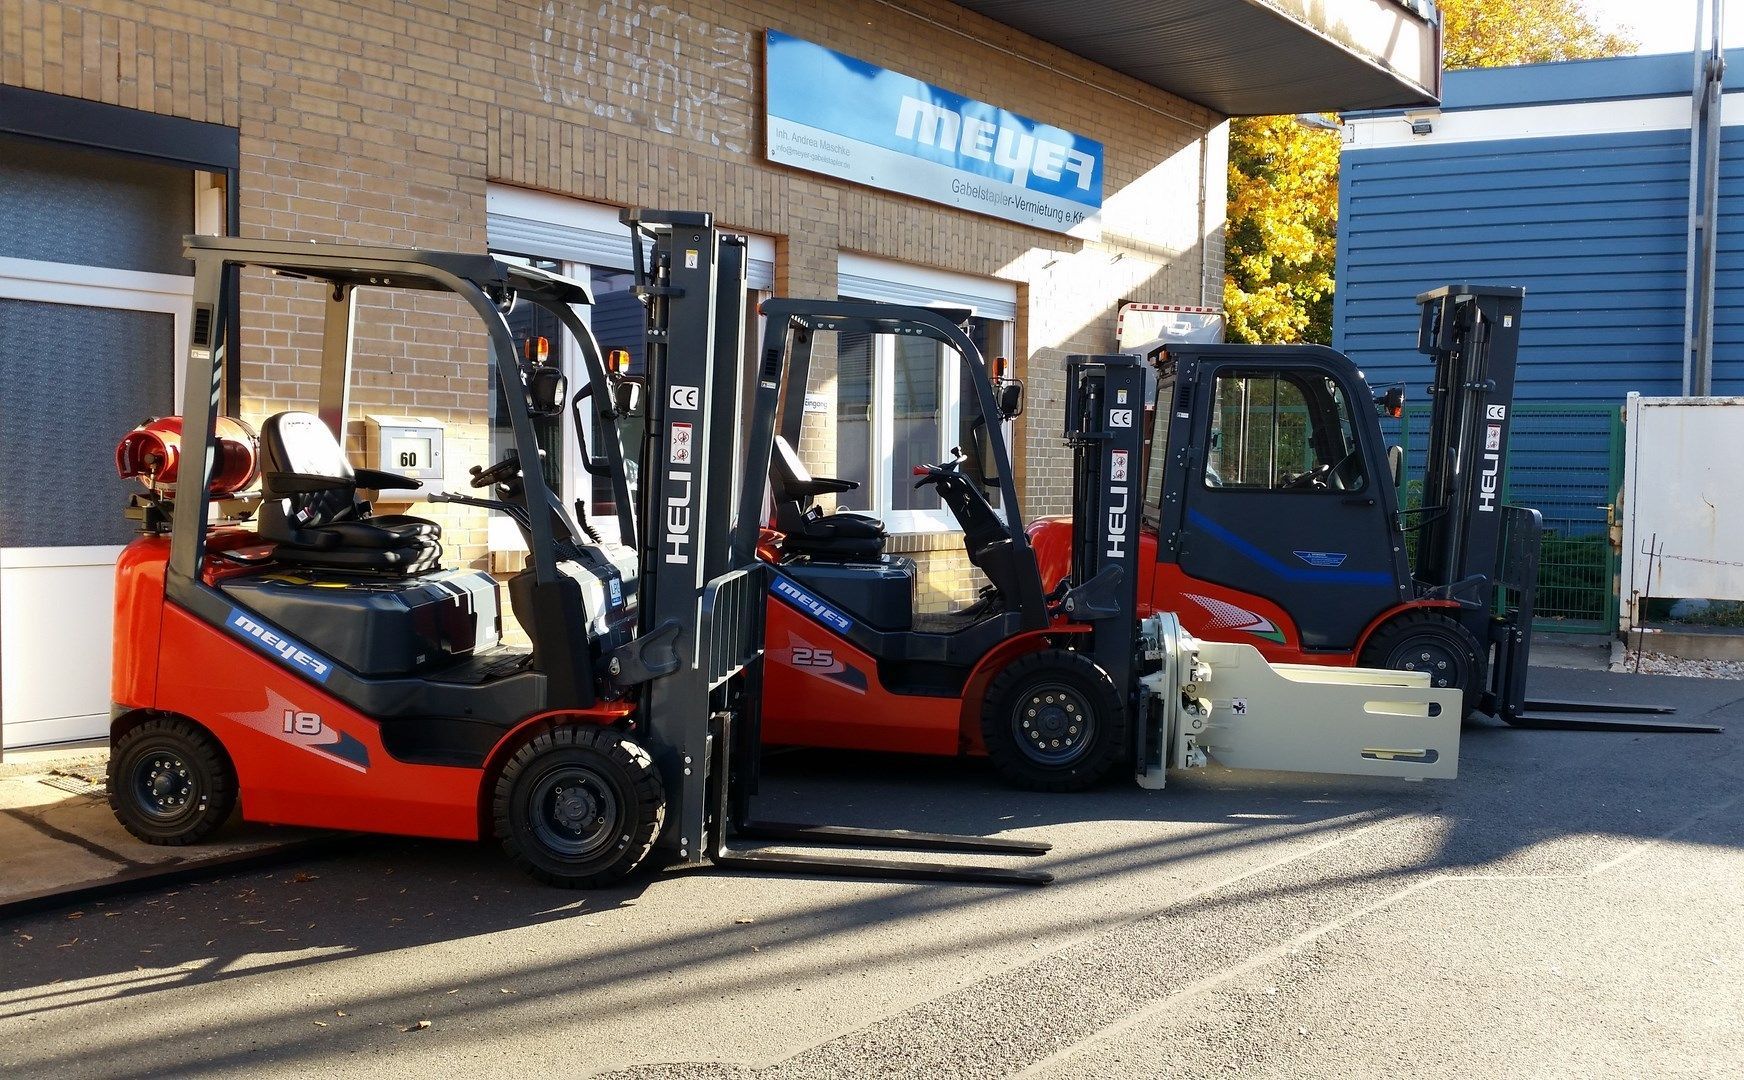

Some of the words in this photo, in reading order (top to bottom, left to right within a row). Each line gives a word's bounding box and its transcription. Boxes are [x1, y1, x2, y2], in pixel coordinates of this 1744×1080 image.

[776, 128, 790, 141] Inh.
[792, 132, 818, 148] Andrea
[820, 138, 851, 156] Maschke
[952, 178, 1063, 224] Gabelstapler-Vermietung
[400, 451, 417, 467] 60
[1478, 453, 1499, 512] HELI
[665, 471, 692, 564] HELI
[1106, 486, 1129, 558] HELI
[791, 647, 834, 668] 25
[282, 709, 322, 735] 18
